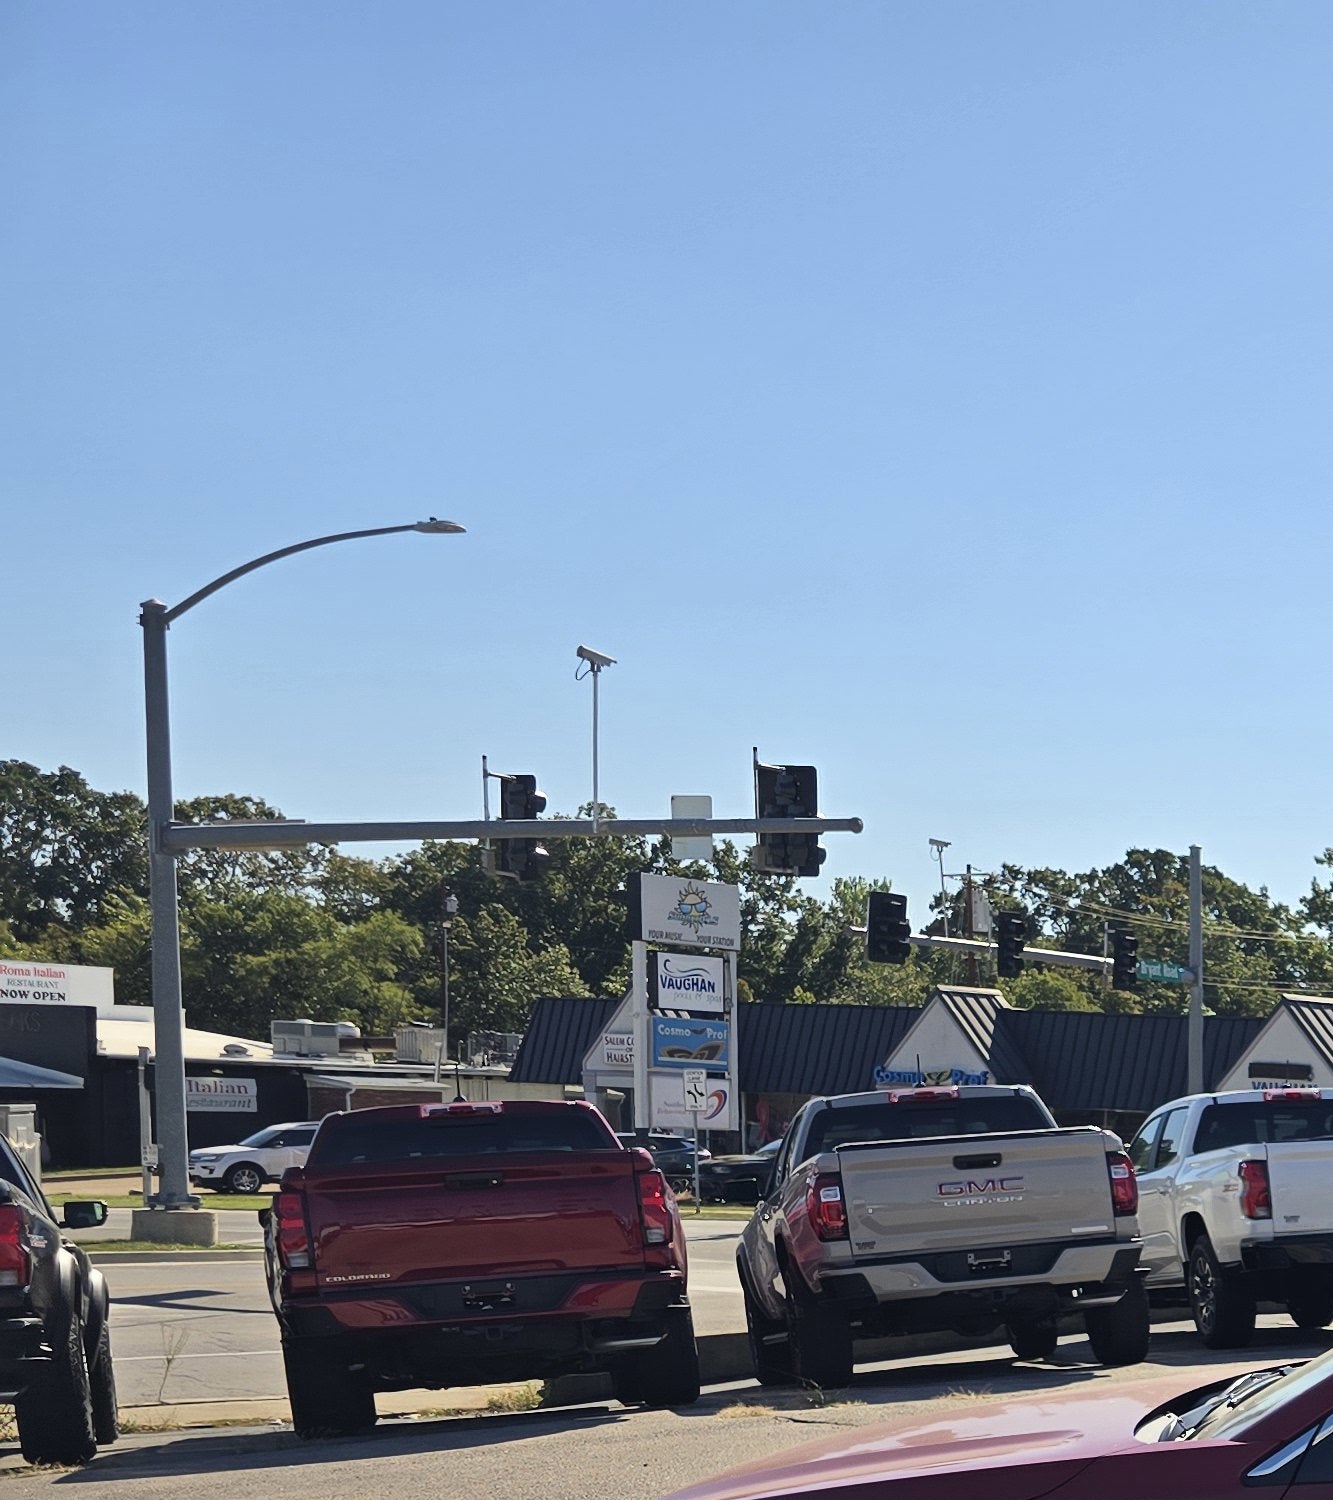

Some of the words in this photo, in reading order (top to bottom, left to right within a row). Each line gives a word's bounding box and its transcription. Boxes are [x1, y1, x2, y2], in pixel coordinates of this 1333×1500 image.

[0, 964, 31, 977] Roma
[33, 966, 66, 979] Italian
[7, 978, 59, 989] RESTAURANT
[660, 974, 716, 994] VAUGHAN
[0, 988, 30, 1000] NOW
[33, 991, 66, 1002] OPEN
[657, 1024, 692, 1037] Cosmo
[706, 1027, 728, 1040] Prof
[187, 1079, 248, 1095] Italian
[187, 1098, 251, 1109] estaurant
[937, 1176, 1025, 1198] GMC
